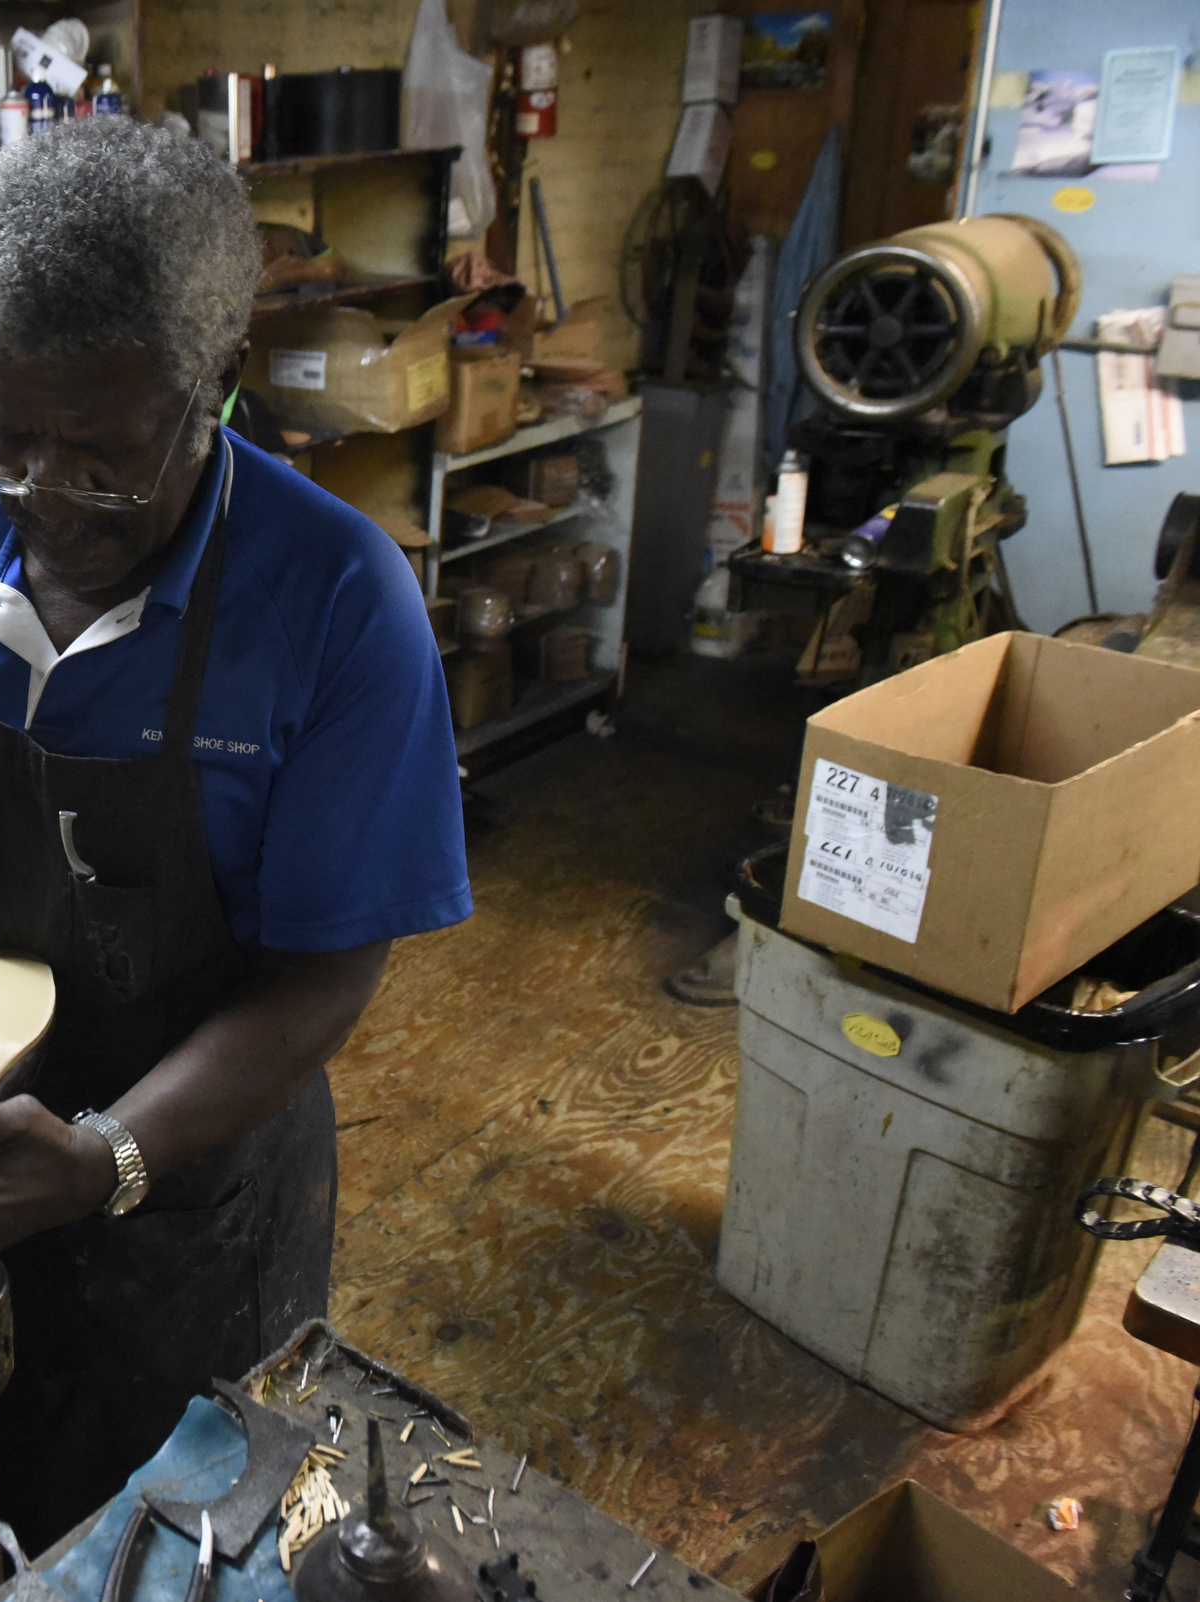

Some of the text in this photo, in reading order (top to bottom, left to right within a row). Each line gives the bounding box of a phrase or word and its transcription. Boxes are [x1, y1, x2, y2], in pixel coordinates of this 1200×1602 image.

[193, 736, 225, 750] SHOE
[227, 740, 260, 755] SHOP
[827, 767, 860, 793] 227
[870, 787, 881, 802] 4
